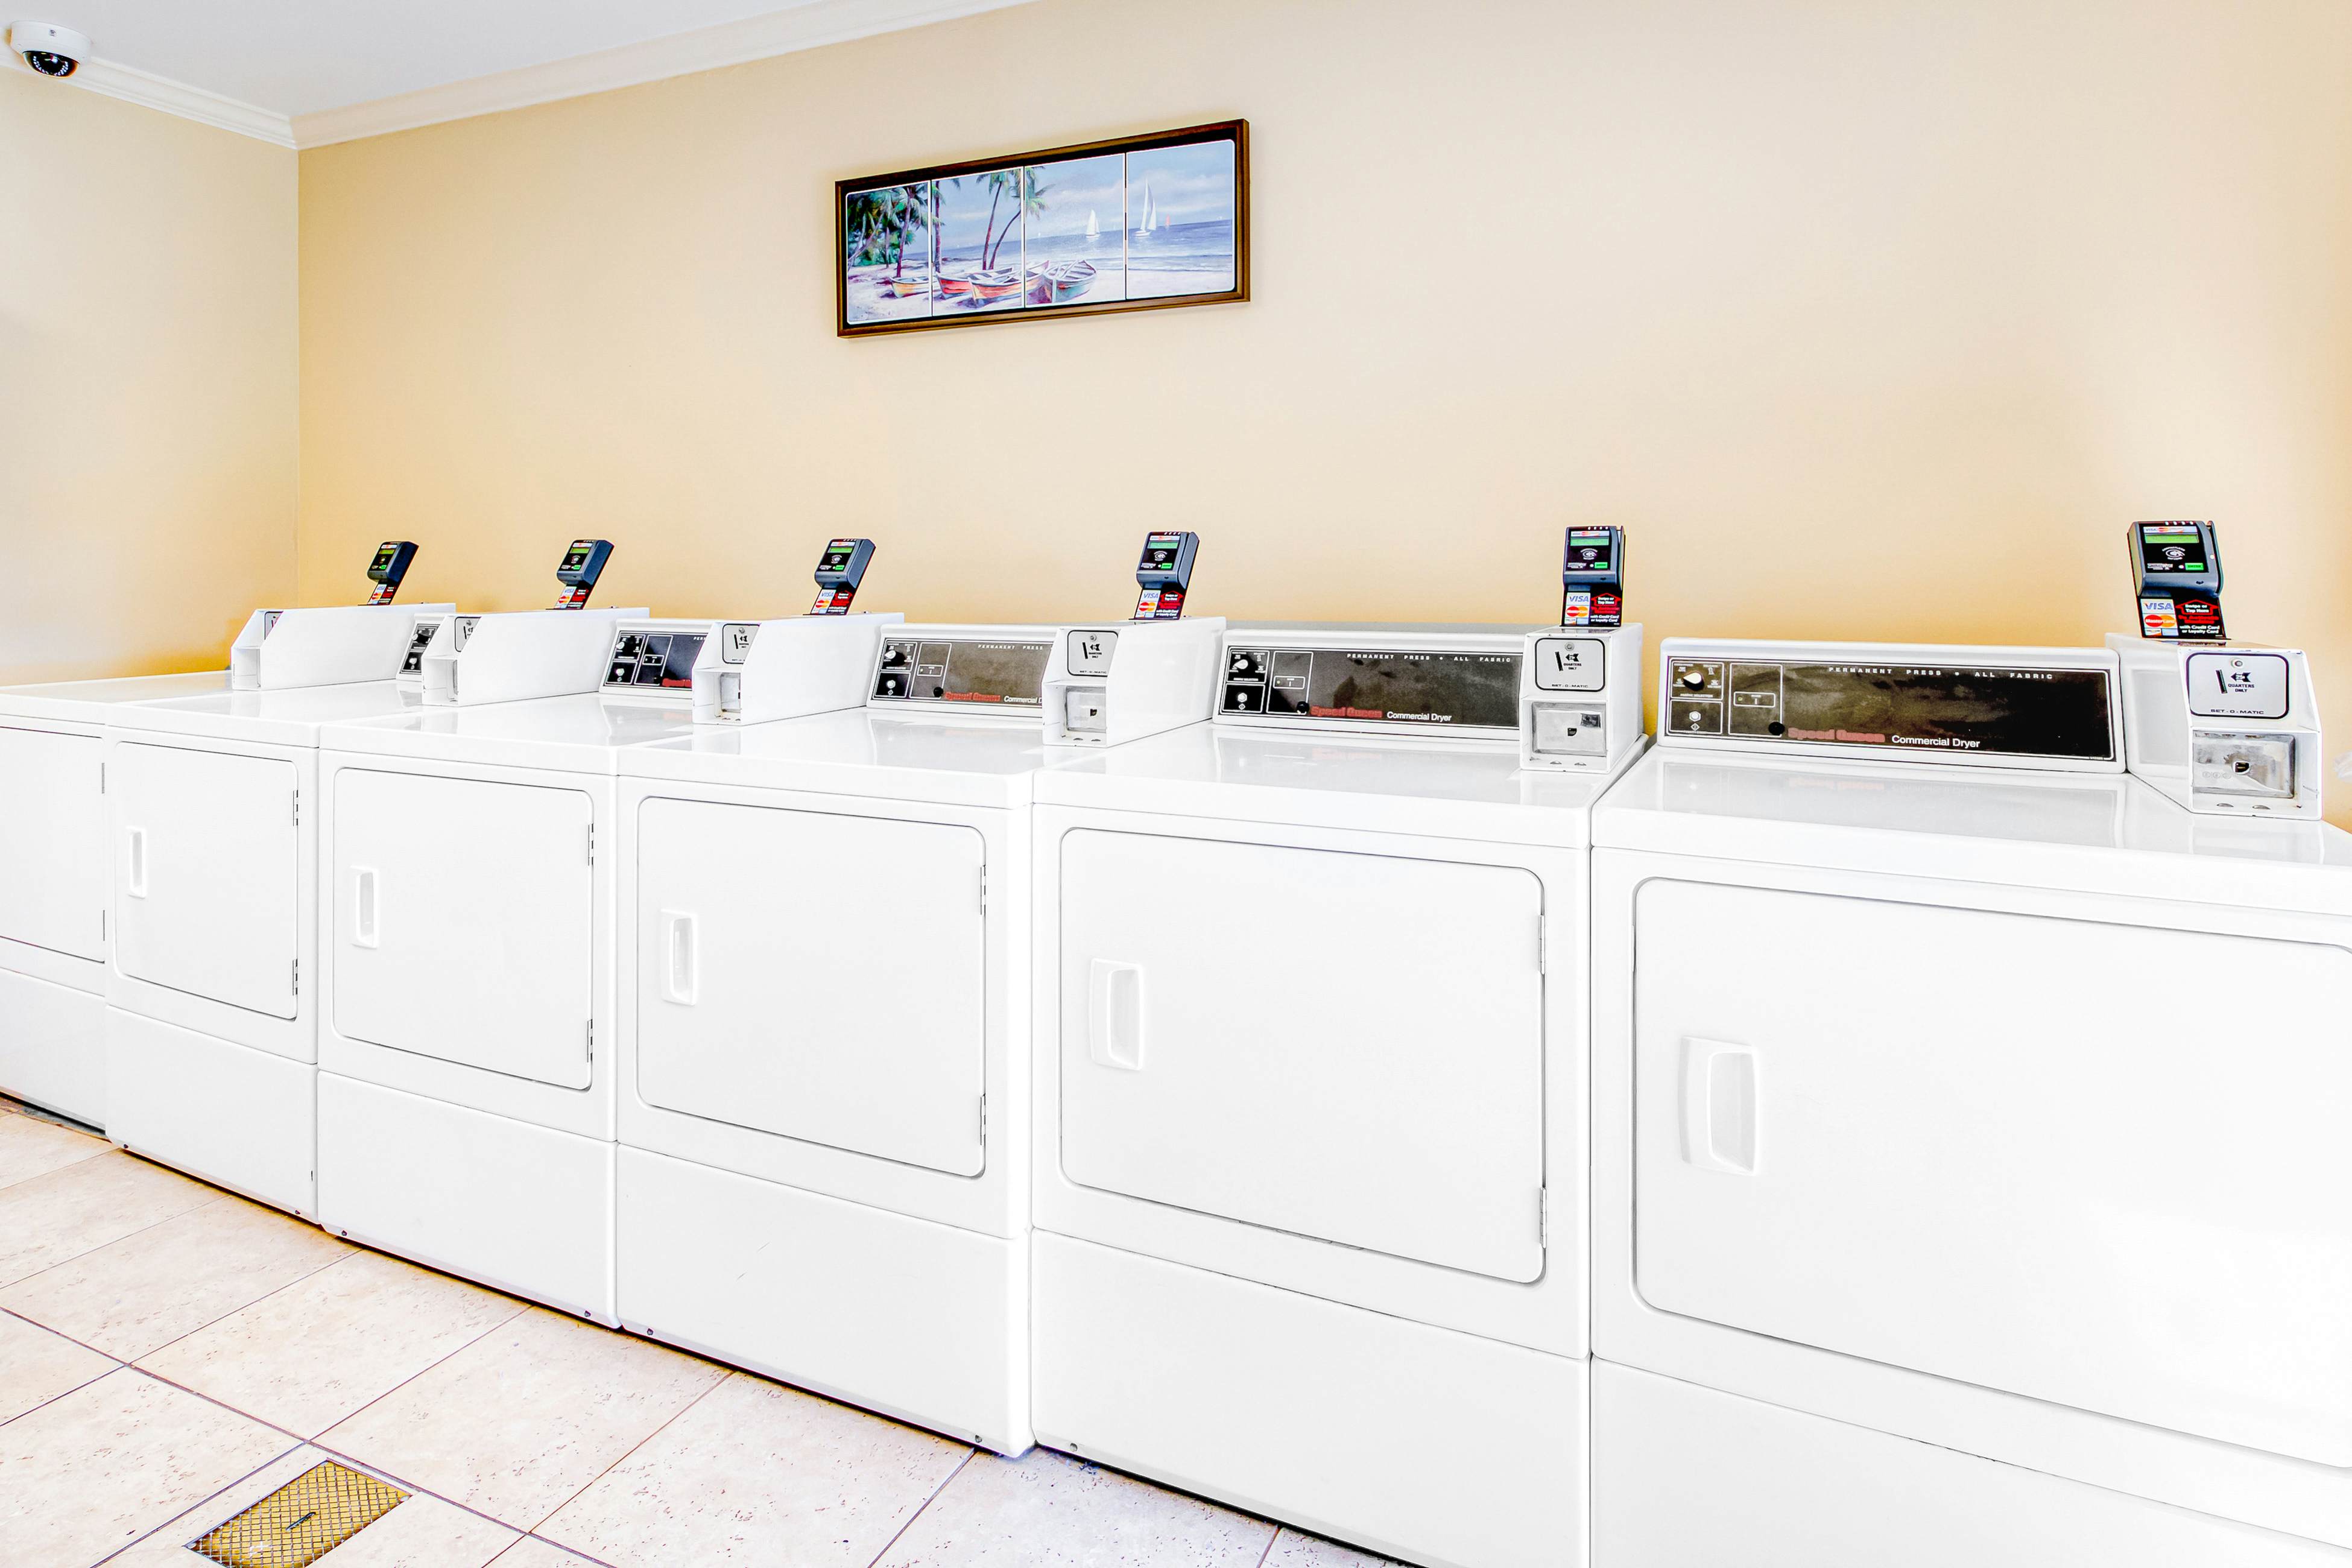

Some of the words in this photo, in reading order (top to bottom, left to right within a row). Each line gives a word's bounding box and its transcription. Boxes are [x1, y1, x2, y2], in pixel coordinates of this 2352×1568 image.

[1310, 706, 1347, 716] Speed
[1346, 707, 1383, 718] Queen
[1386, 710, 1429, 721] Commercial
[1431, 713, 1452, 722] Dryer
[1891, 735, 1950, 746] Commercial
[1952, 739, 1981, 749] Dryer
